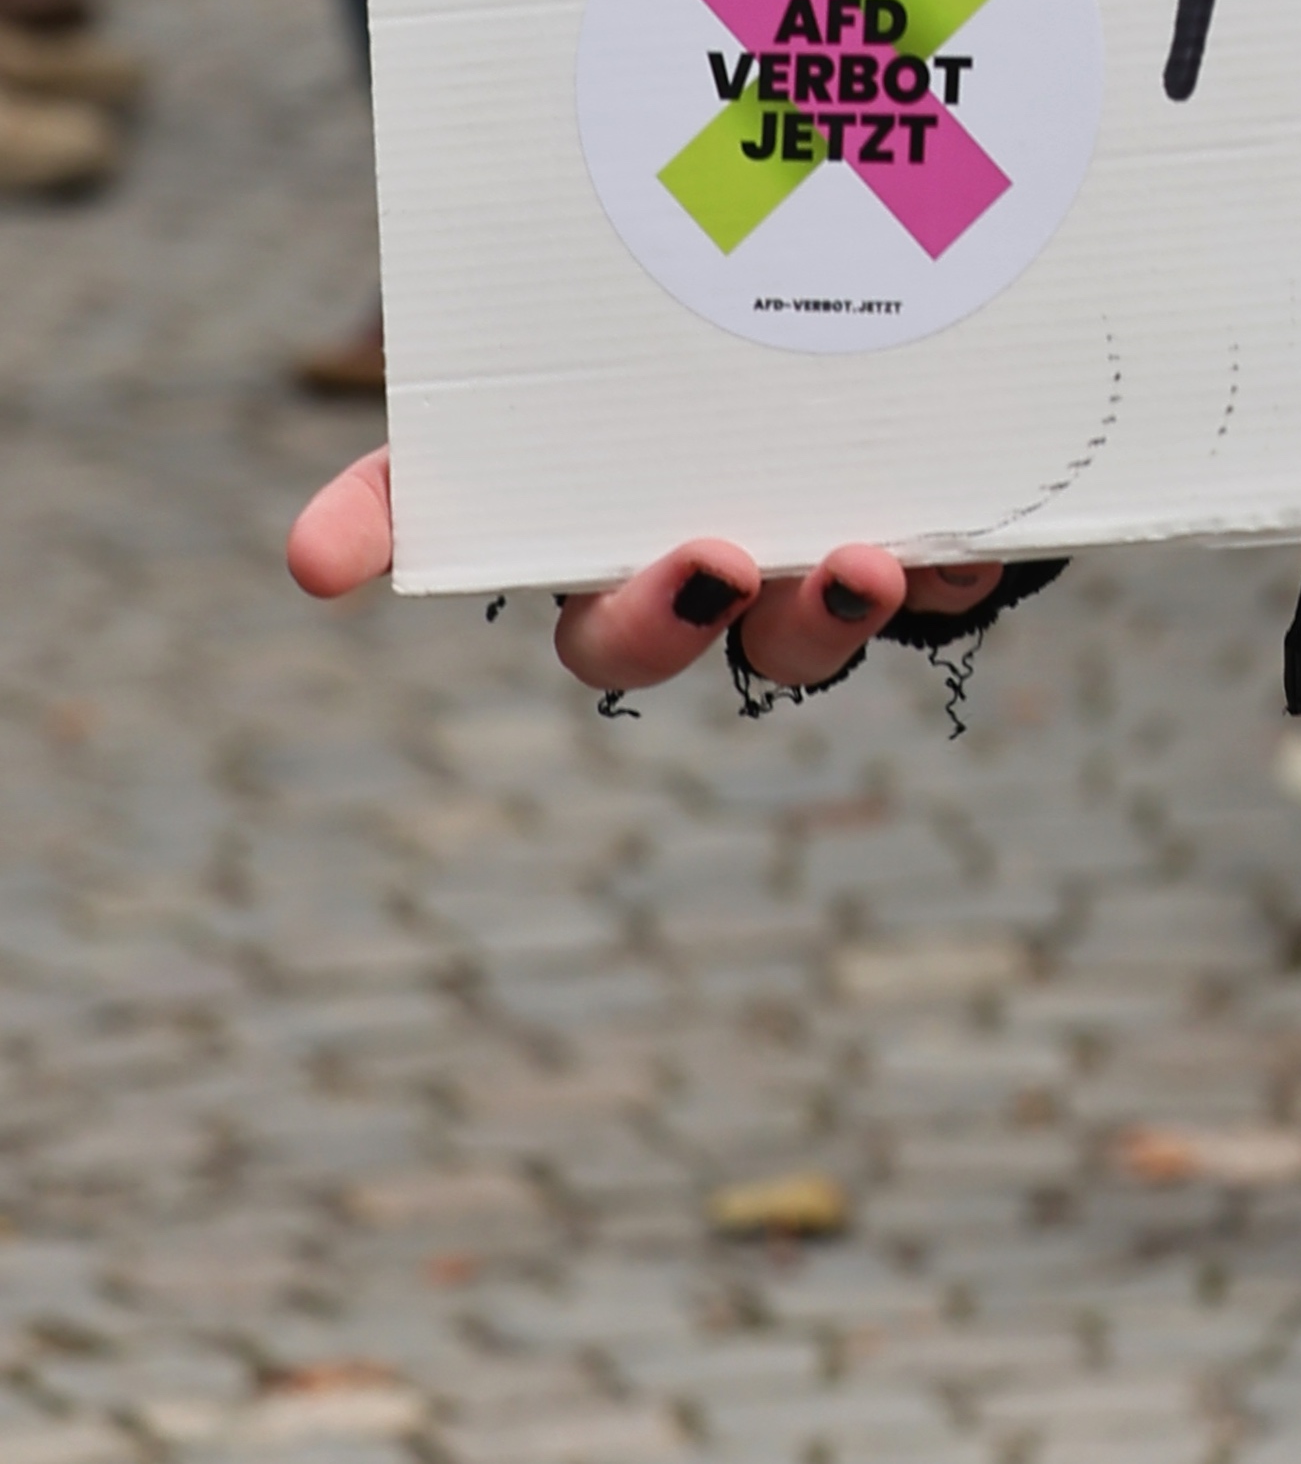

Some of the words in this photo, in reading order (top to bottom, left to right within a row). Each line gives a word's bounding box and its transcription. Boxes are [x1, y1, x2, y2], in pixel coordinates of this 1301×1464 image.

[707, 51, 973, 106] VERBOT
[740, 110, 939, 165] JETZT
[753, 297, 902, 314] AFD-VERBOT.JETZT
